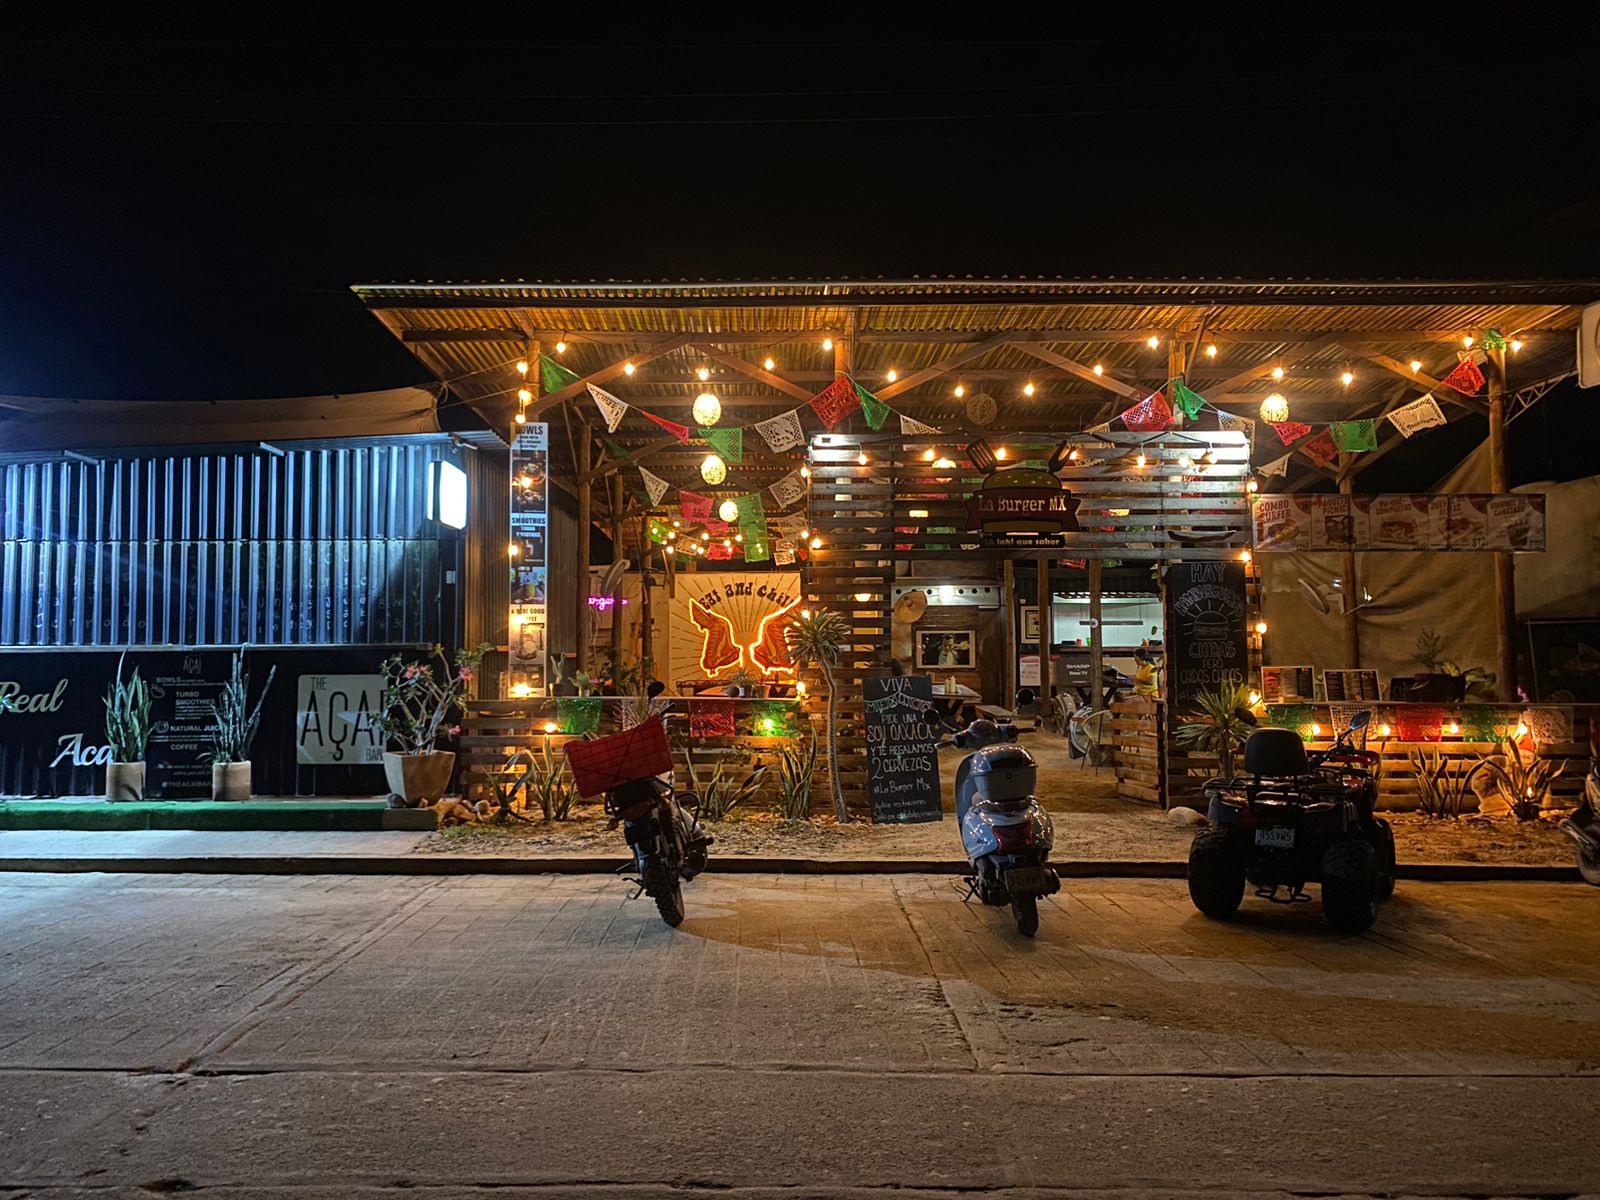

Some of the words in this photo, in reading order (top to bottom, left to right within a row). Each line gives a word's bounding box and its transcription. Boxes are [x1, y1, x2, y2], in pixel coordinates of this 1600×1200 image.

[997, 497, 1045, 515] Burger
[1259, 499, 1289, 512] COMBO
[1260, 509, 1291, 522] SURFER
[1190, 563, 1225, 582] HAY
[724, 582, 753, 598] and
[310, 677, 327, 690] THE
[880, 678, 912, 692] VIVA
[0, 678, 69, 714] Real
[902, 713, 918, 723] UNA
[170, 724, 202, 732] NATURAL
[204, 724, 220, 732] JUIC
[890, 722, 935, 741] OAXACA
[48, 732, 114, 769] Aca
[366, 748, 383, 761] BAR
[889, 743, 934, 757] REGALAMOS
[871, 756, 884, 780] 2
[882, 755, 932, 774] CERVEZAS
